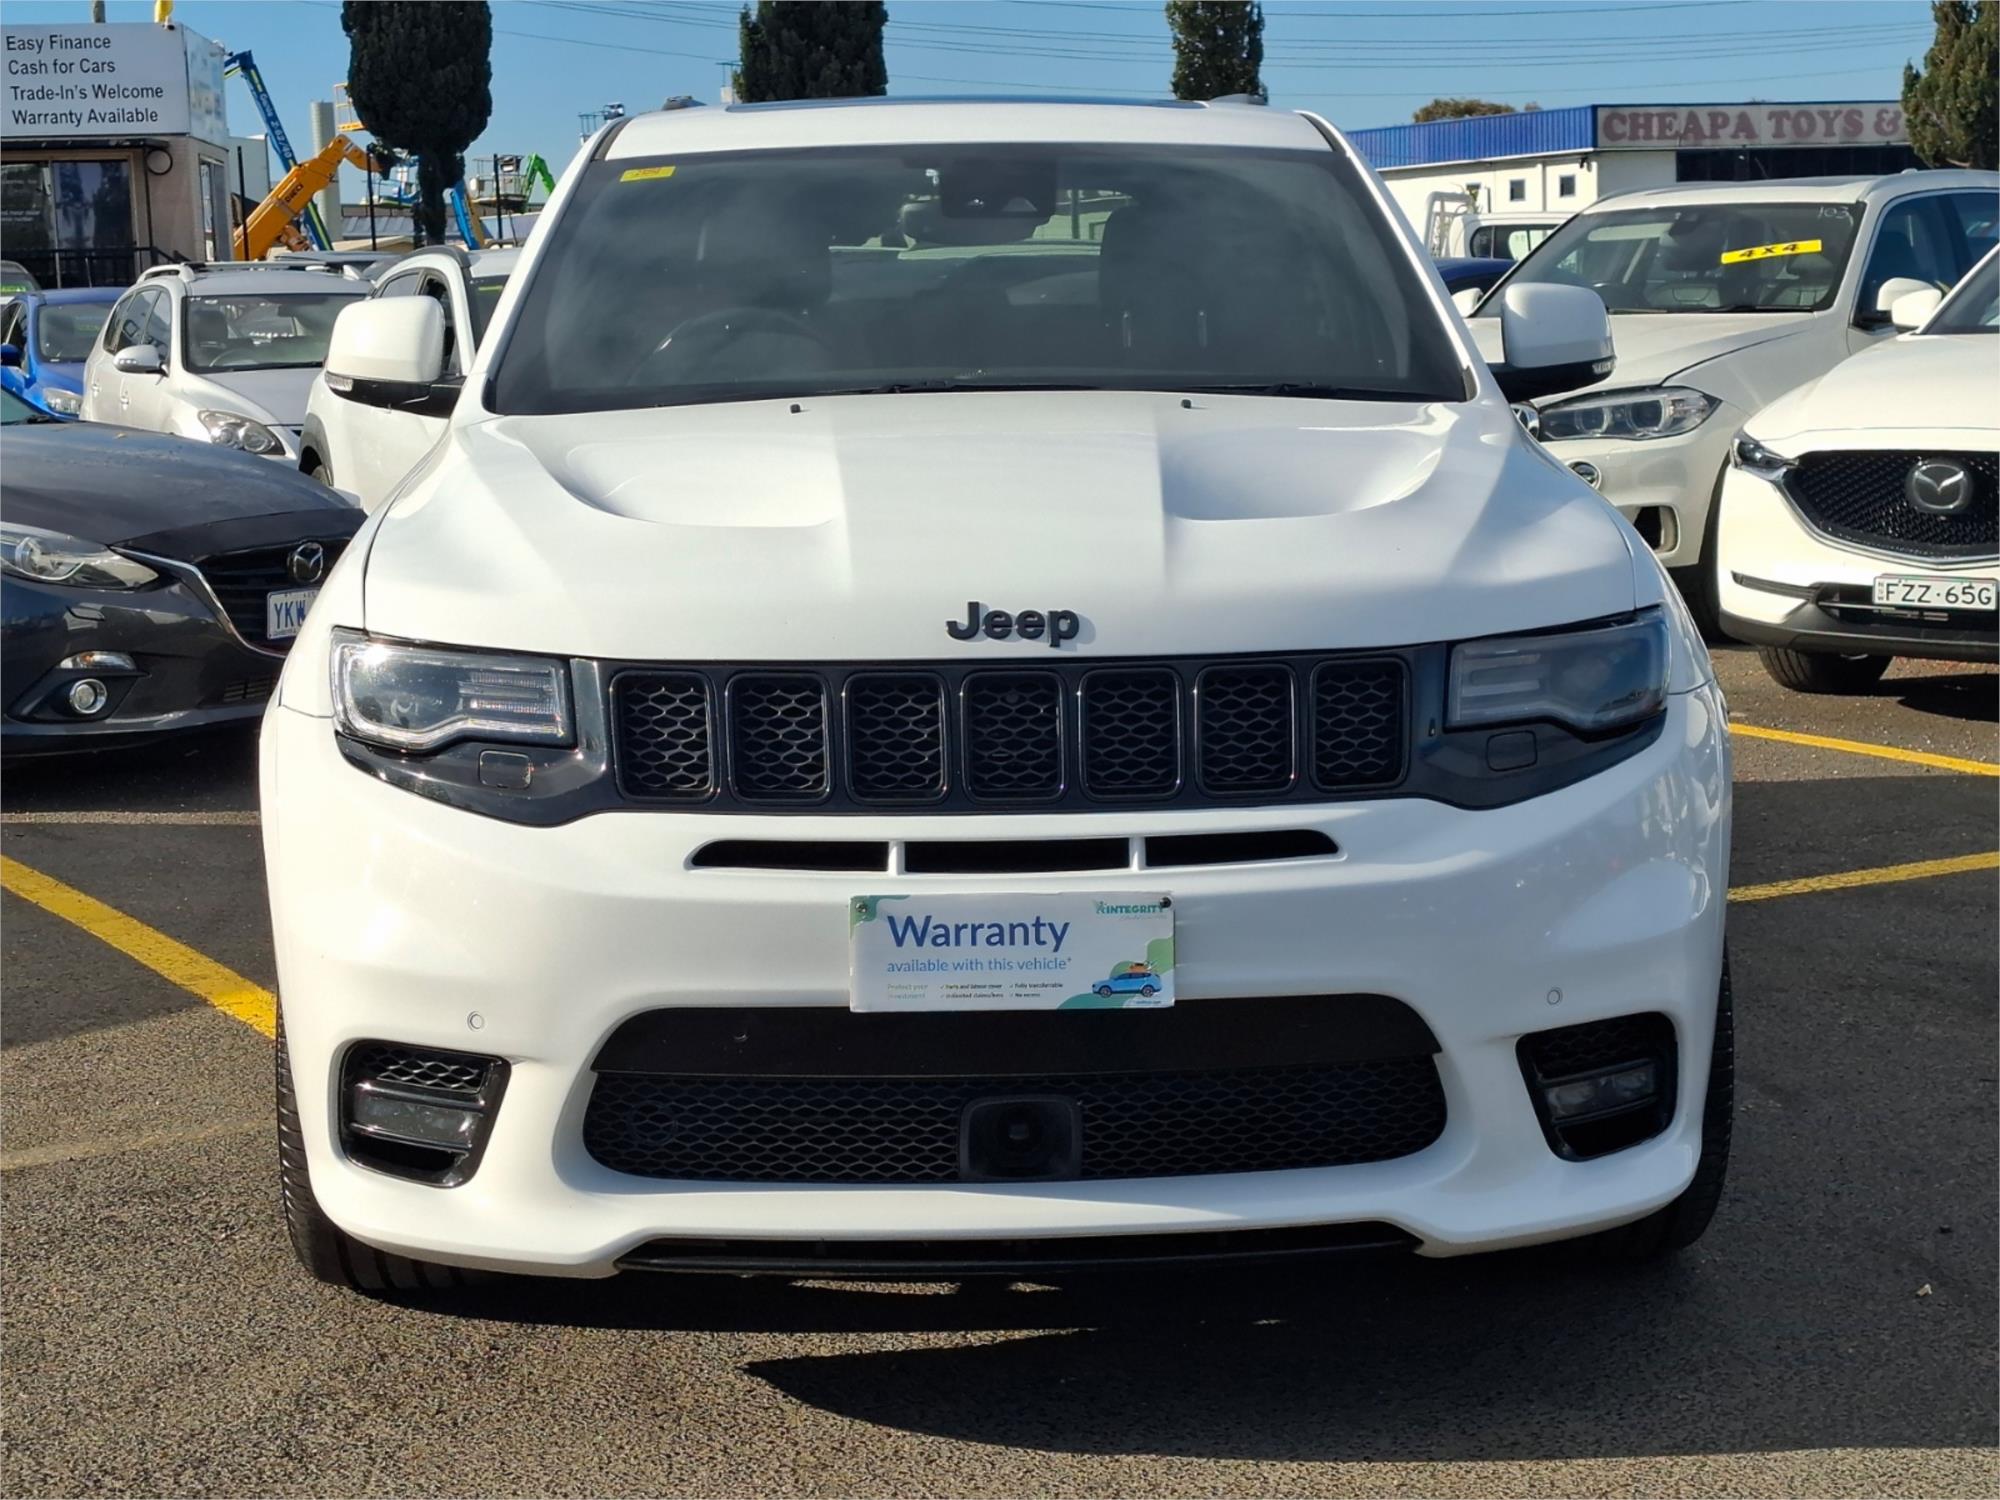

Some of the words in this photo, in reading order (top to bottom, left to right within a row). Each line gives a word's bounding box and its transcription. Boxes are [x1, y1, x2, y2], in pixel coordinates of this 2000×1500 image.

[6, 36, 44, 54] Easy
[50, 35, 111, 50] Finance
[8, 60, 48, 75] Cash
[53, 59, 75, 74] for
[79, 58, 116, 73] Cars
[10, 85, 87, 101] Trade-In's
[92, 84, 163, 99] Welcome
[12, 109, 83, 127] Warranty
[87, 108, 158, 124] Available
[1602, 110, 1759, 142] CHEAPA
[1767, 109, 1865, 139] TOYS
[1873, 108, 1902, 138] &
[946, 601, 1080, 648] Jeep
[887, 915, 1070, 952] Warranty
[887, 959, 949, 973] available
[952, 958, 984, 972] with
[988, 957, 1014, 971] this
